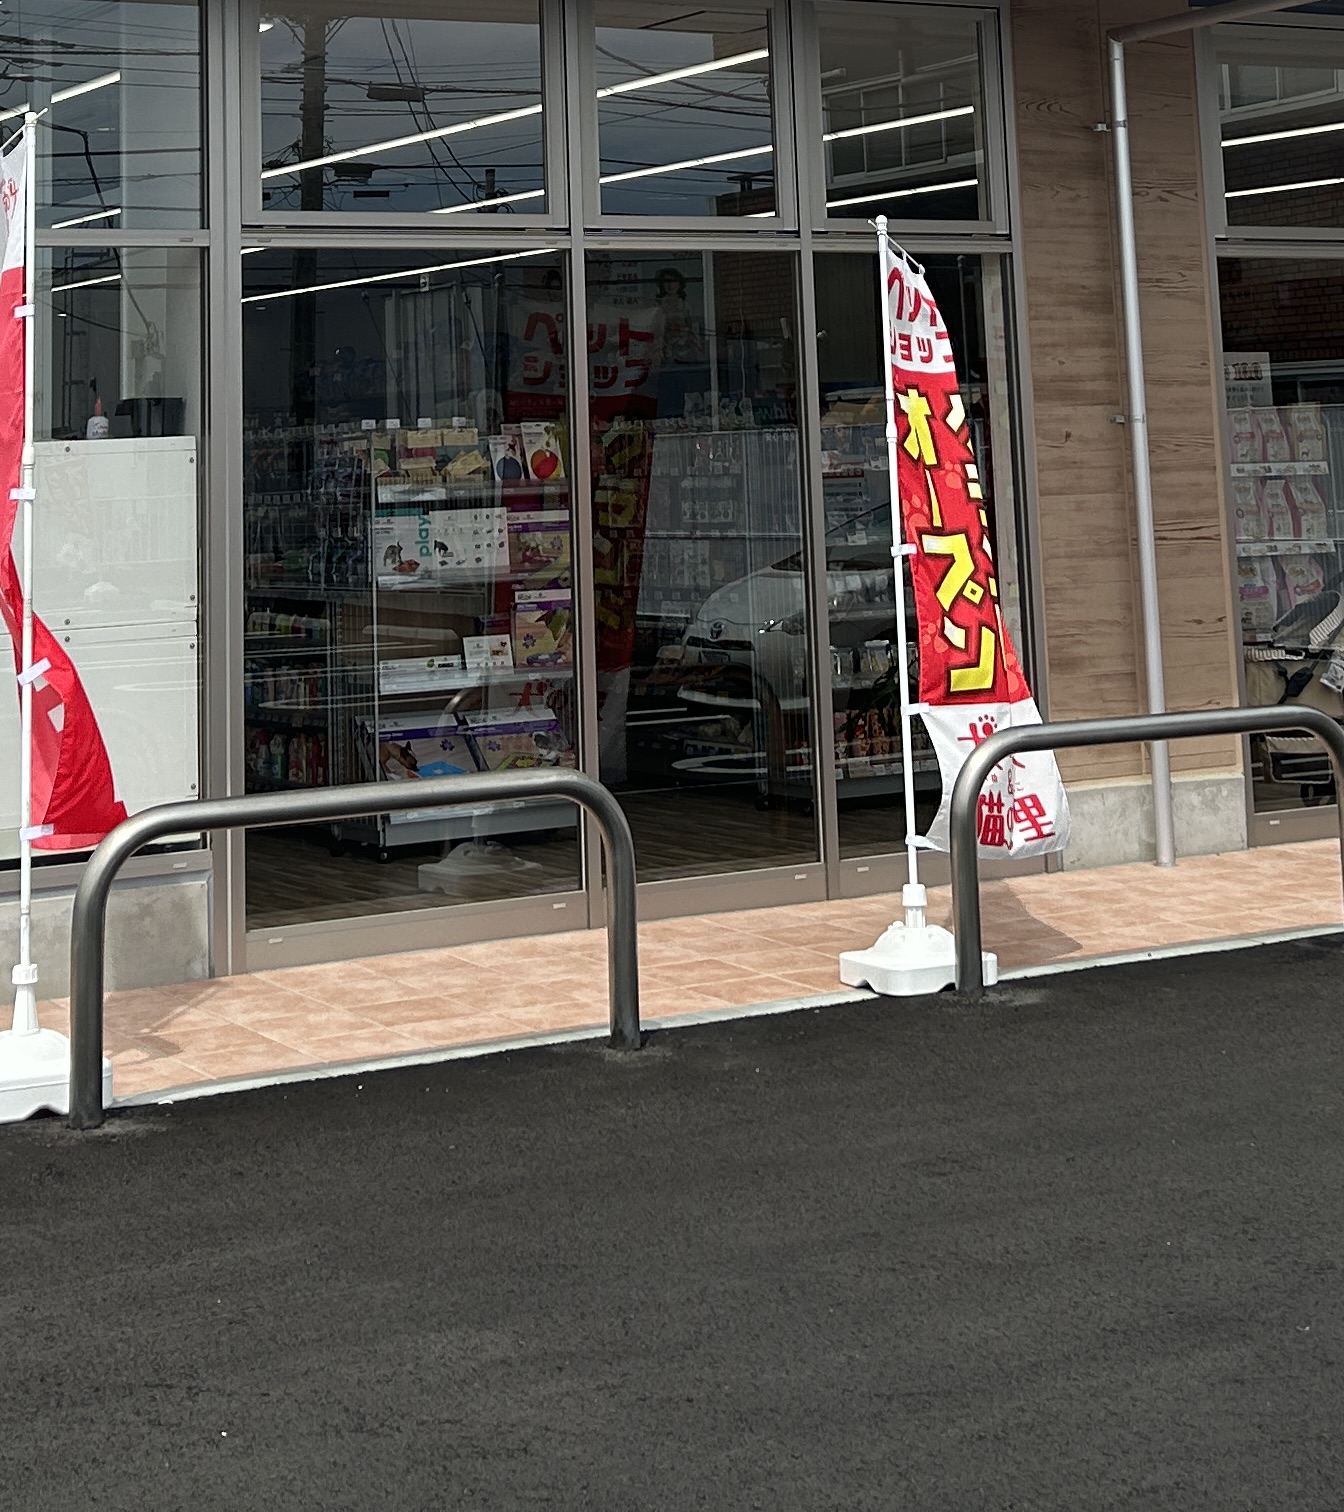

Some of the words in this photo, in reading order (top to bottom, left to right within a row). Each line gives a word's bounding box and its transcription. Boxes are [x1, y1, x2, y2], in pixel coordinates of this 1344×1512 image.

[890, 329, 954, 364] ョッ
[415, 514, 433, 557] play
[896, 389, 995, 692] オープン
